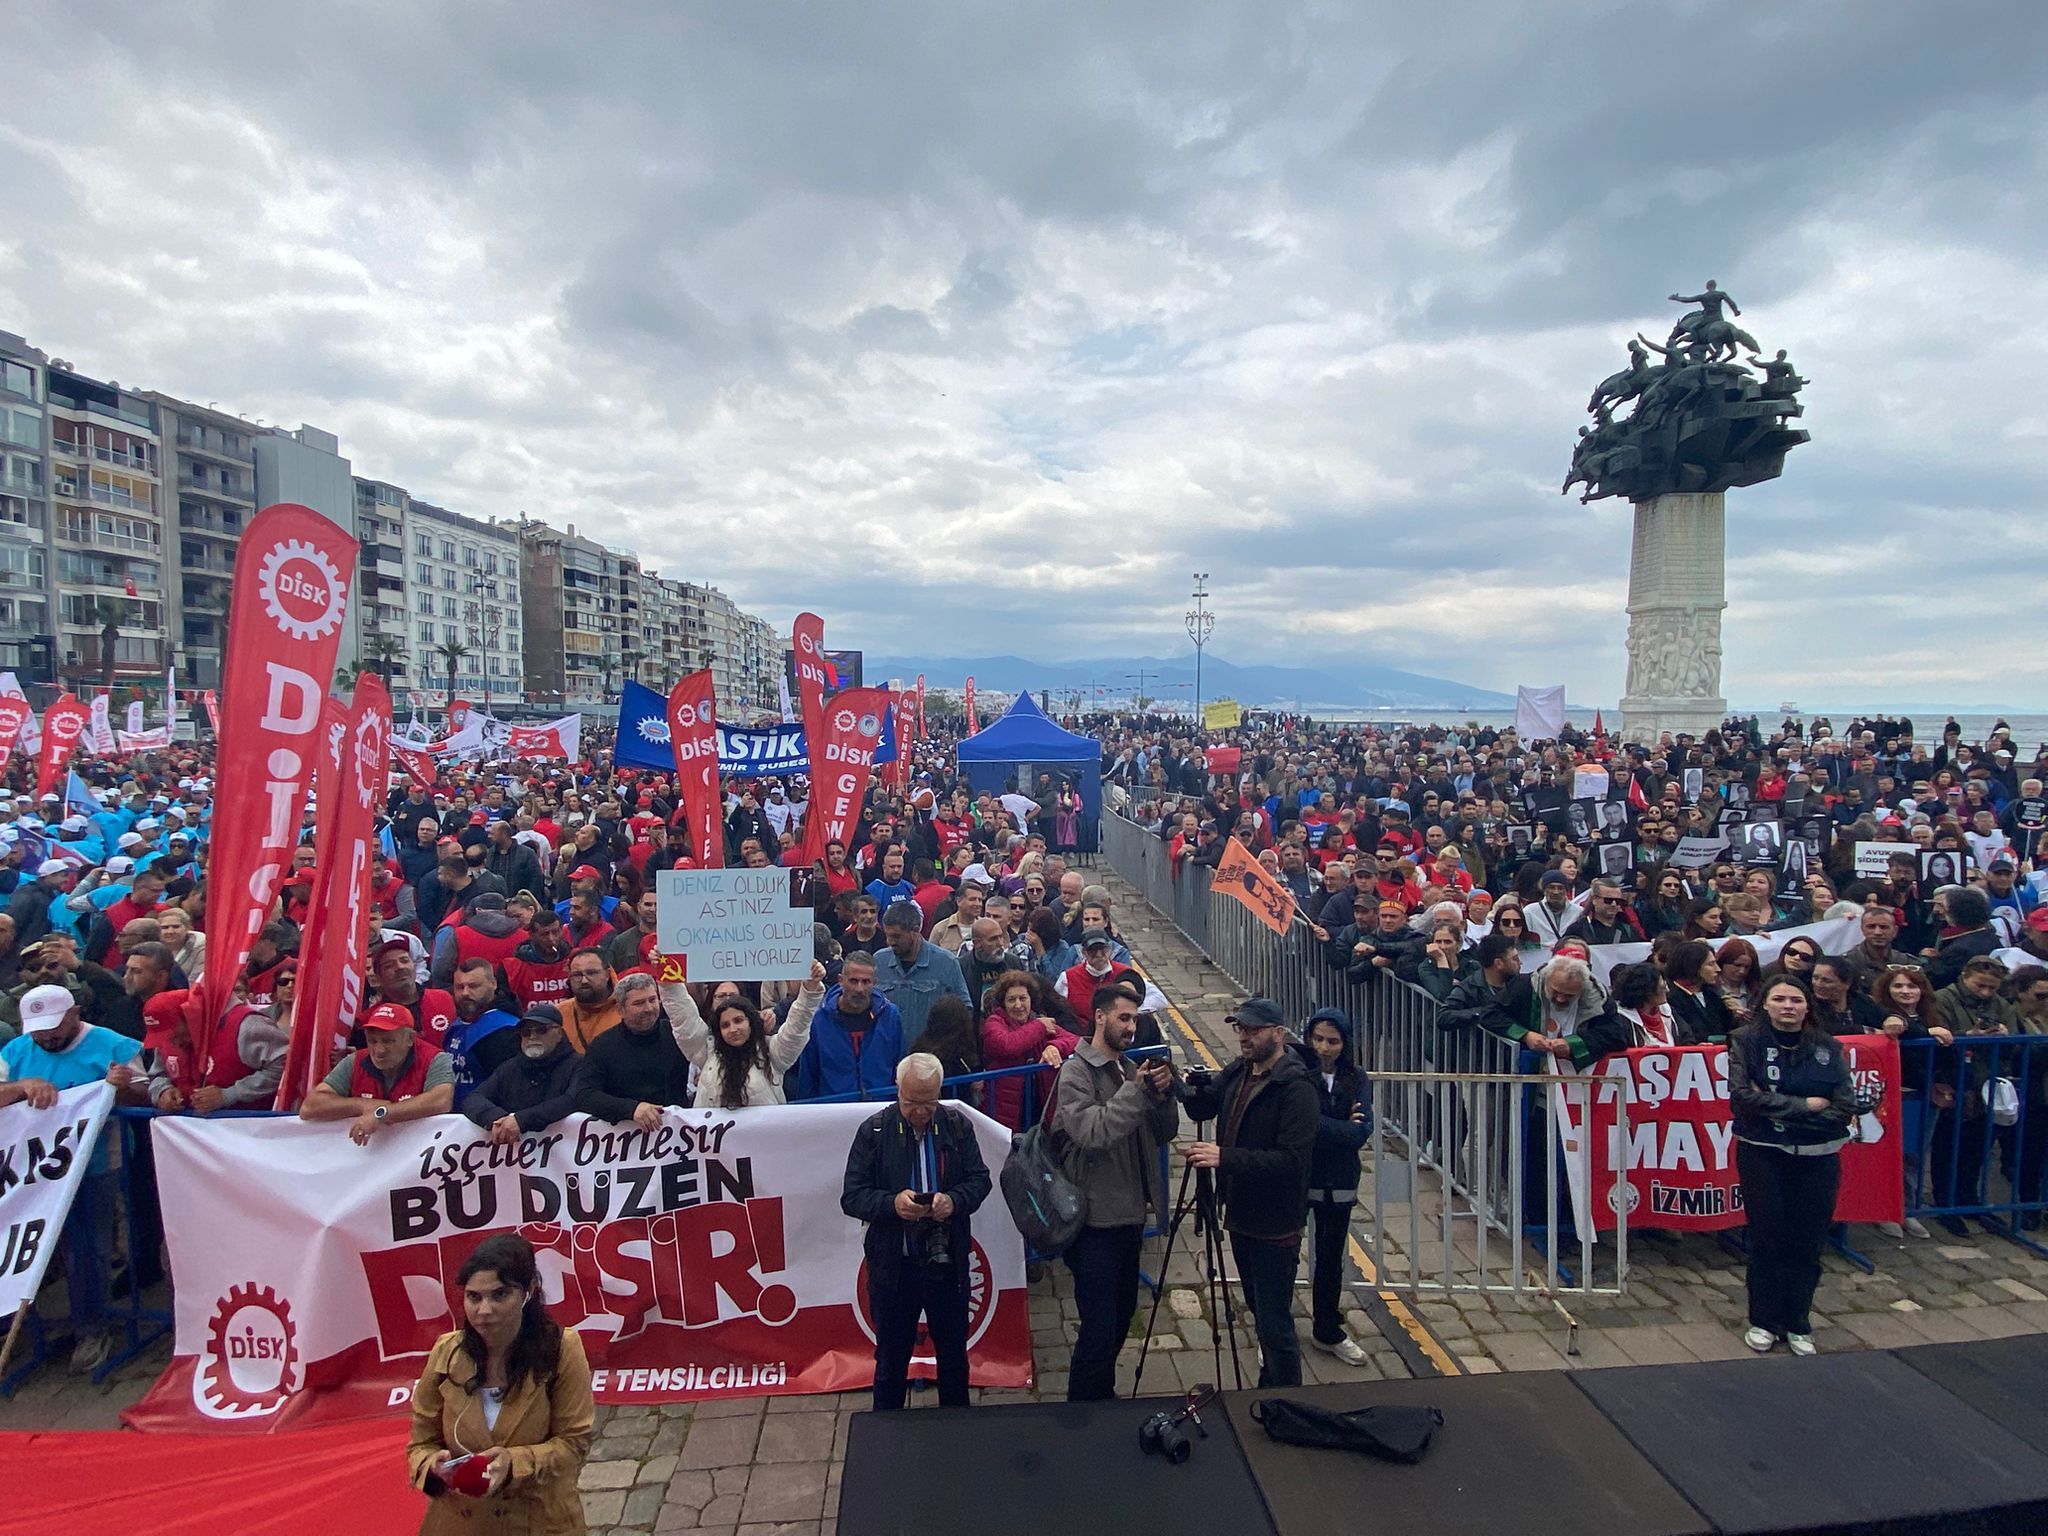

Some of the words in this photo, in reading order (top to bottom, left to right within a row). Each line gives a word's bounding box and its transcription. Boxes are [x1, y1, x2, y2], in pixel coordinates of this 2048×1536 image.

[278, 570, 327, 607] DİSK
[717, 762, 748, 771] MİR
[825, 742, 873, 766] DİSK
[734, 875, 787, 895] OLDUK
[699, 898, 774, 920] ASTINIZ
[676, 924, 755, 948] OKYANUS
[762, 922, 812, 940] OLDUK
[533, 977, 569, 992] DİSK
[575, 1111, 735, 1167] birleşir
[390, 1174, 498, 1242] BU
[519, 1157, 755, 1225] DÜZEN
[1652, 1180, 1727, 1217] İZMİR
[229, 1326, 284, 1363] DİSK
[617, 1361, 786, 1392] TEMSİLCİLİĞİ
